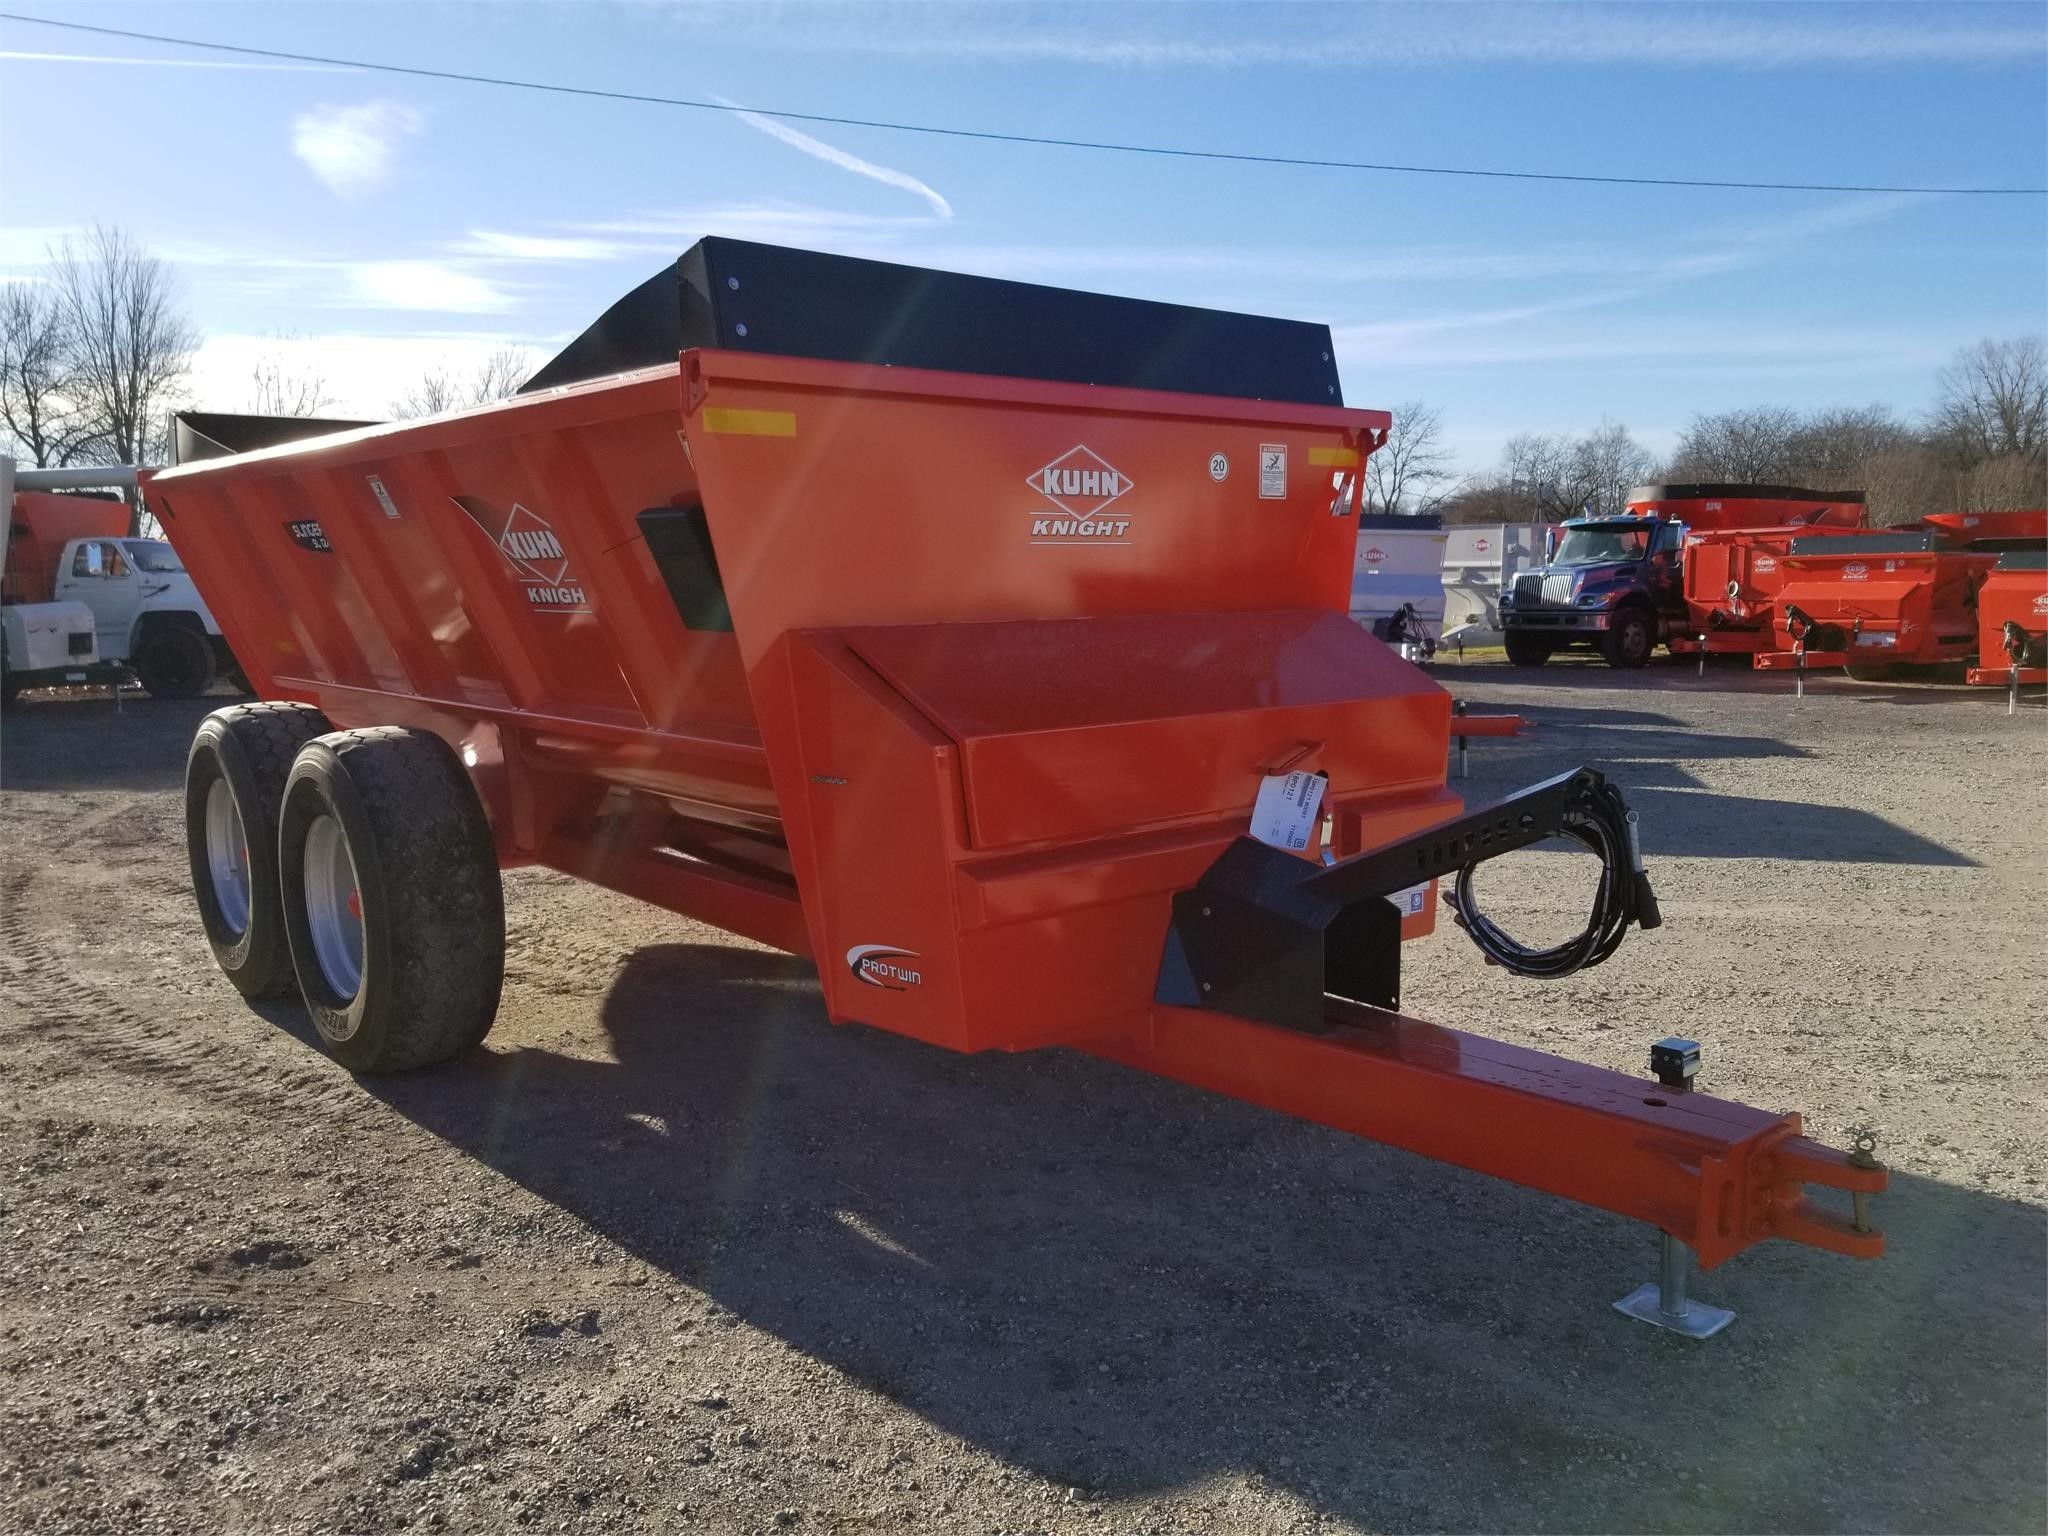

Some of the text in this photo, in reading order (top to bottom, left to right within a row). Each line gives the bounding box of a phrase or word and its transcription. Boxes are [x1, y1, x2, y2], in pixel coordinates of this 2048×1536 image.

[1213, 459, 1225, 472] 20
[1043, 469, 1119, 497] KUHN
[1031, 520, 1130, 536] KNIGHT
[861, 958, 922, 985] PROTWIN
